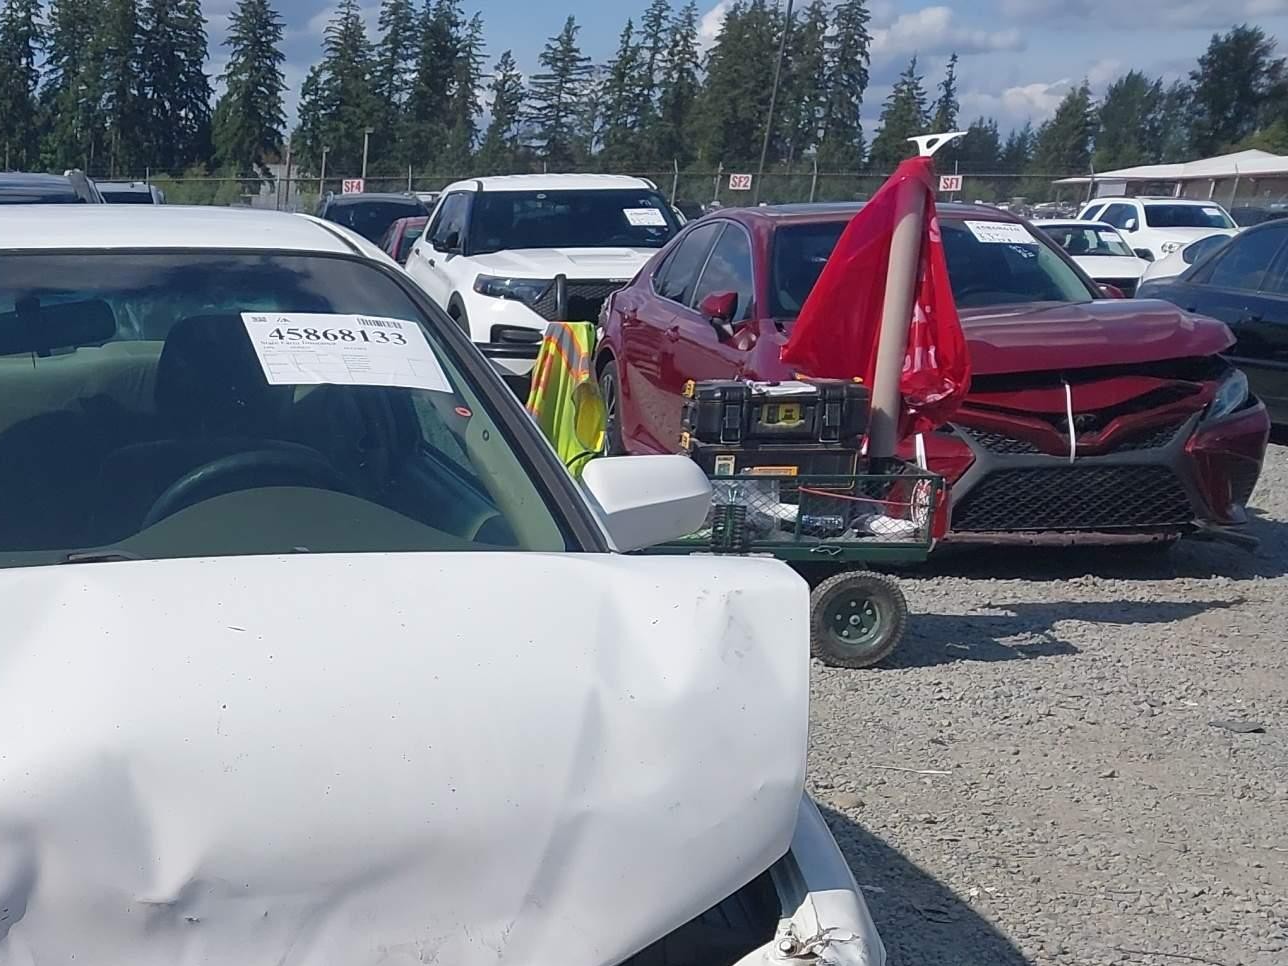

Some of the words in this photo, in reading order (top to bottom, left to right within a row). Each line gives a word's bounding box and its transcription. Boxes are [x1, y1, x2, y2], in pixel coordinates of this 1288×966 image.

[343, 180, 361, 193] SF4
[730, 175, 750, 188] SF2
[268, 327, 408, 346] 45868133
